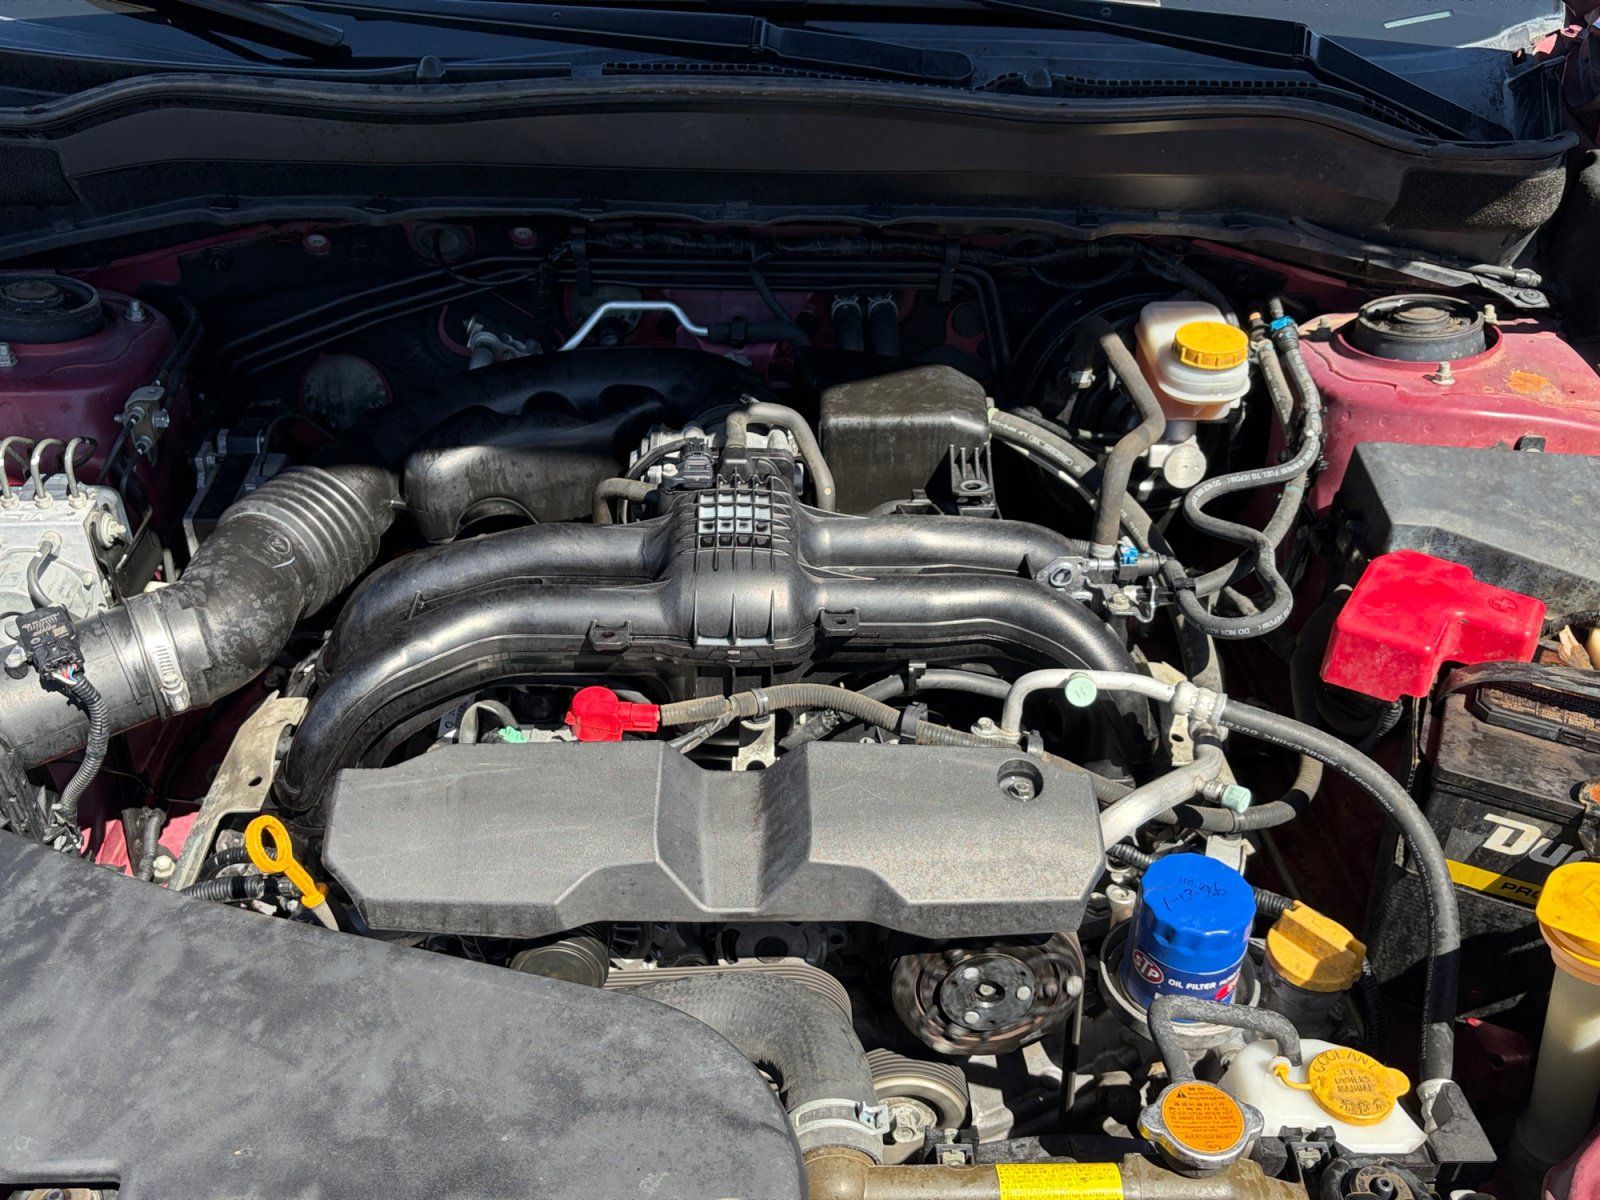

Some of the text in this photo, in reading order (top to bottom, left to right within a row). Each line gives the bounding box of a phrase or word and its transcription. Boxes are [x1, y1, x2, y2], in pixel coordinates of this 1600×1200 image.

[1134, 953, 1161, 979] STP
[1167, 978, 1184, 989] OIL
[1185, 981, 1218, 991] FILTER
